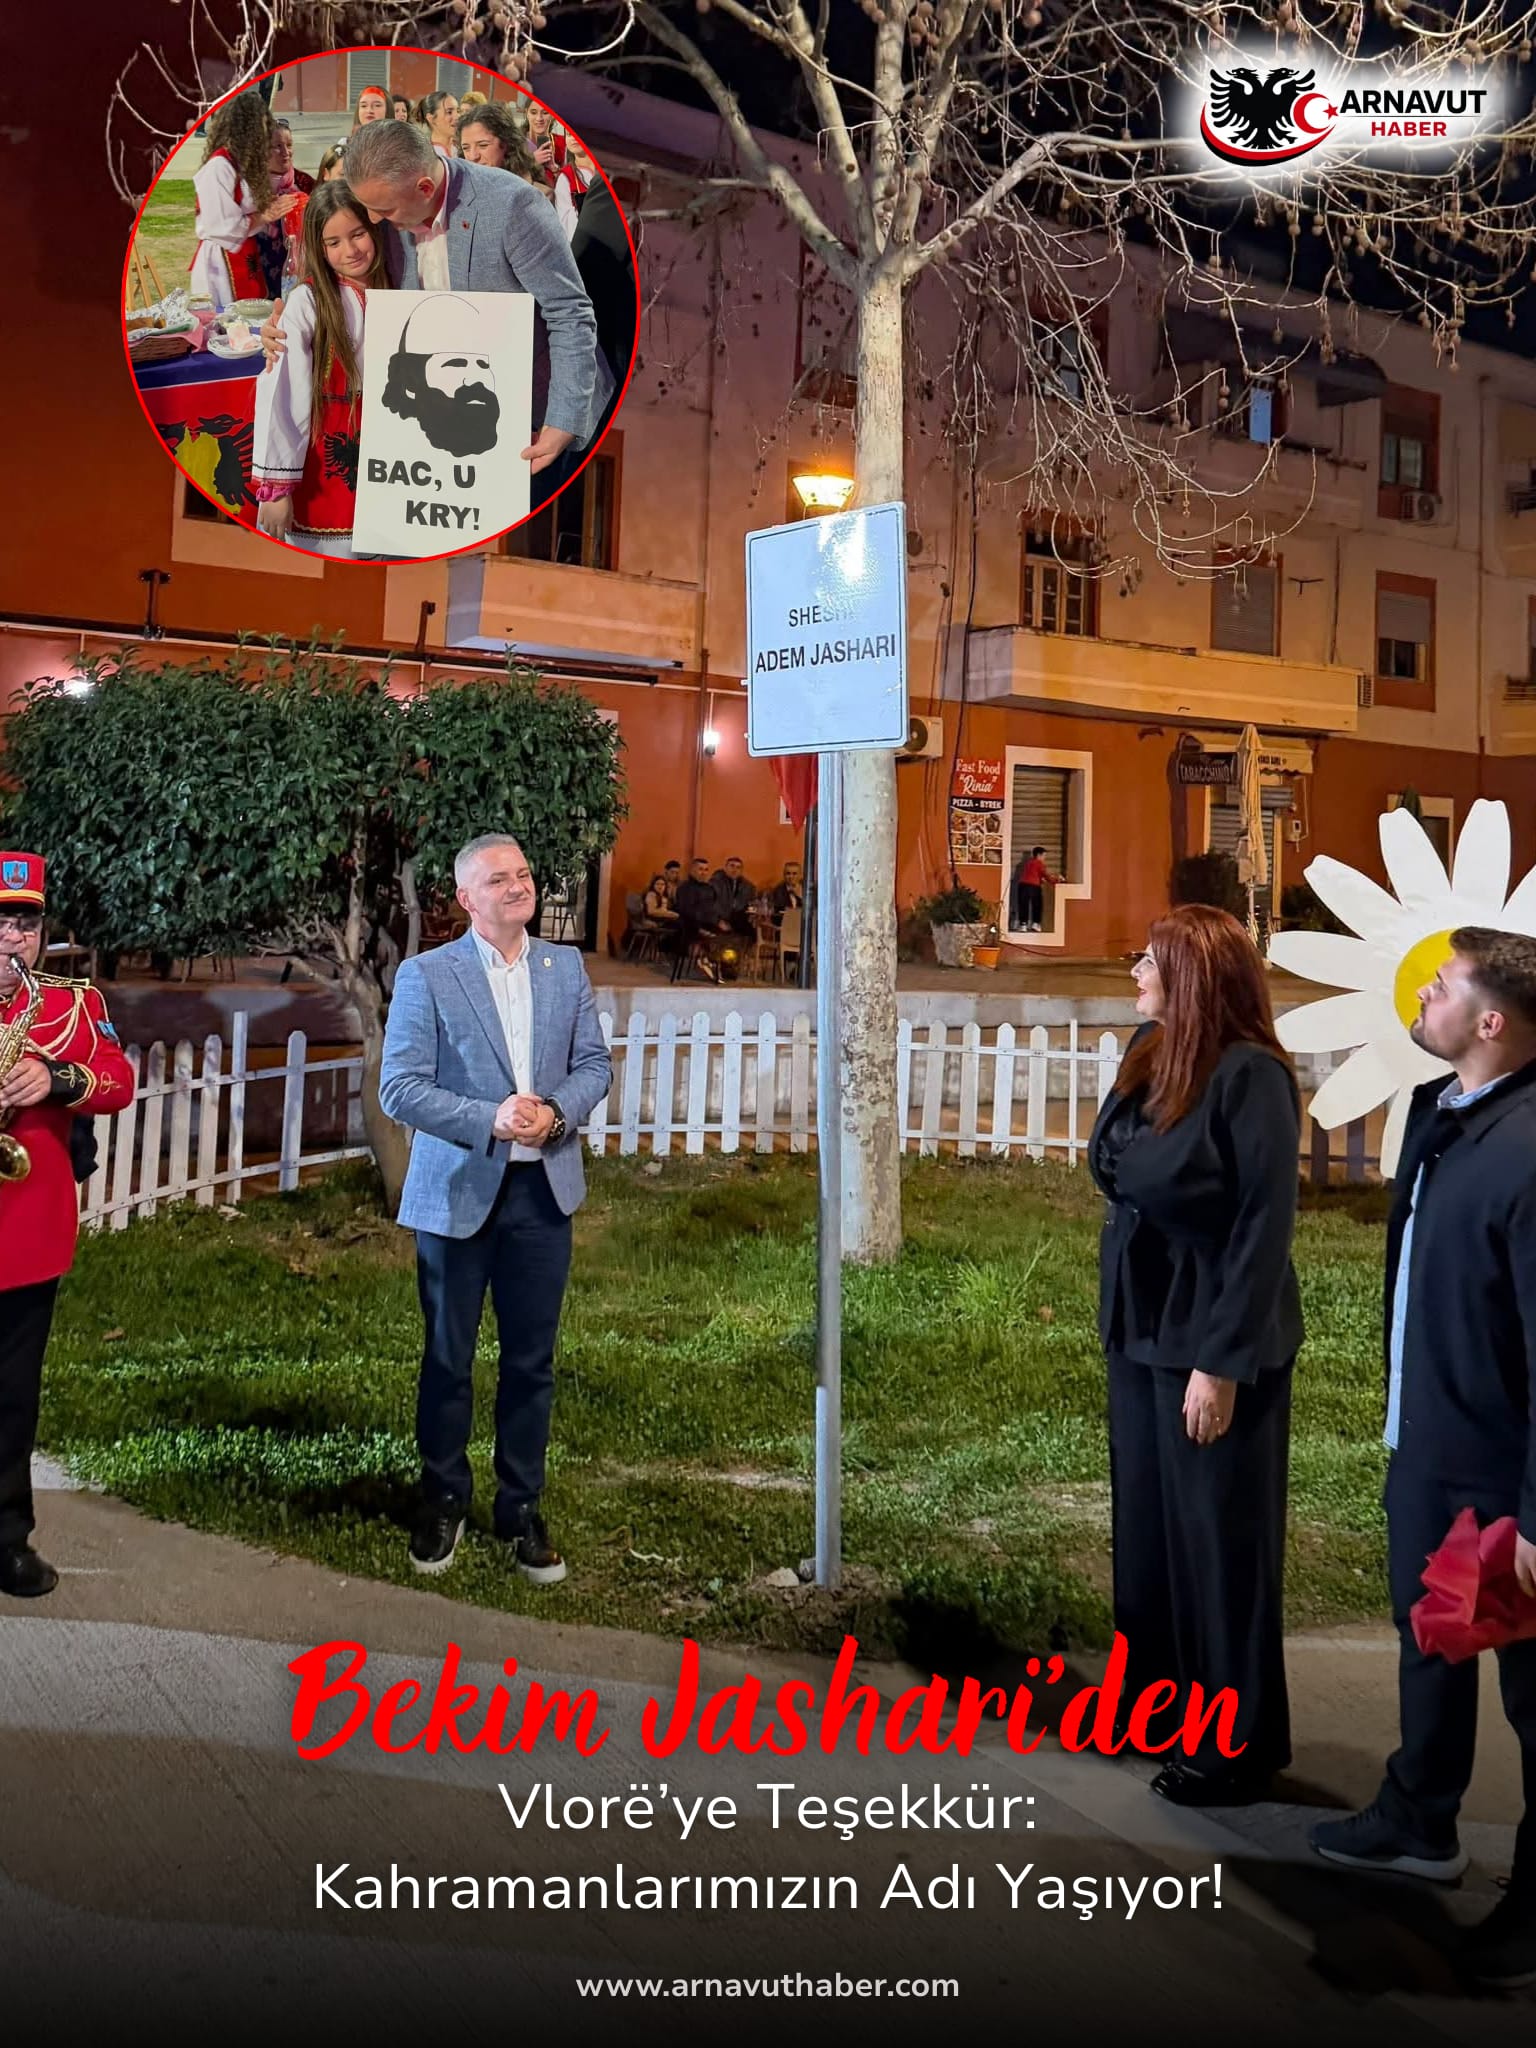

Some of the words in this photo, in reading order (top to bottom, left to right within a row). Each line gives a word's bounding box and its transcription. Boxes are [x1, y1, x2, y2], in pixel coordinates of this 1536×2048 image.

[367, 458, 442, 492] BAC,
[453, 465, 476, 489] U
[405, 499, 480, 531] KRY!
[755, 645, 805, 674] ADEM
[810, 633, 896, 666] JASHARI
[956, 759, 976, 773] Fast
[978, 759, 1001, 775] Food
[952, 798, 974, 808] PIZZA
